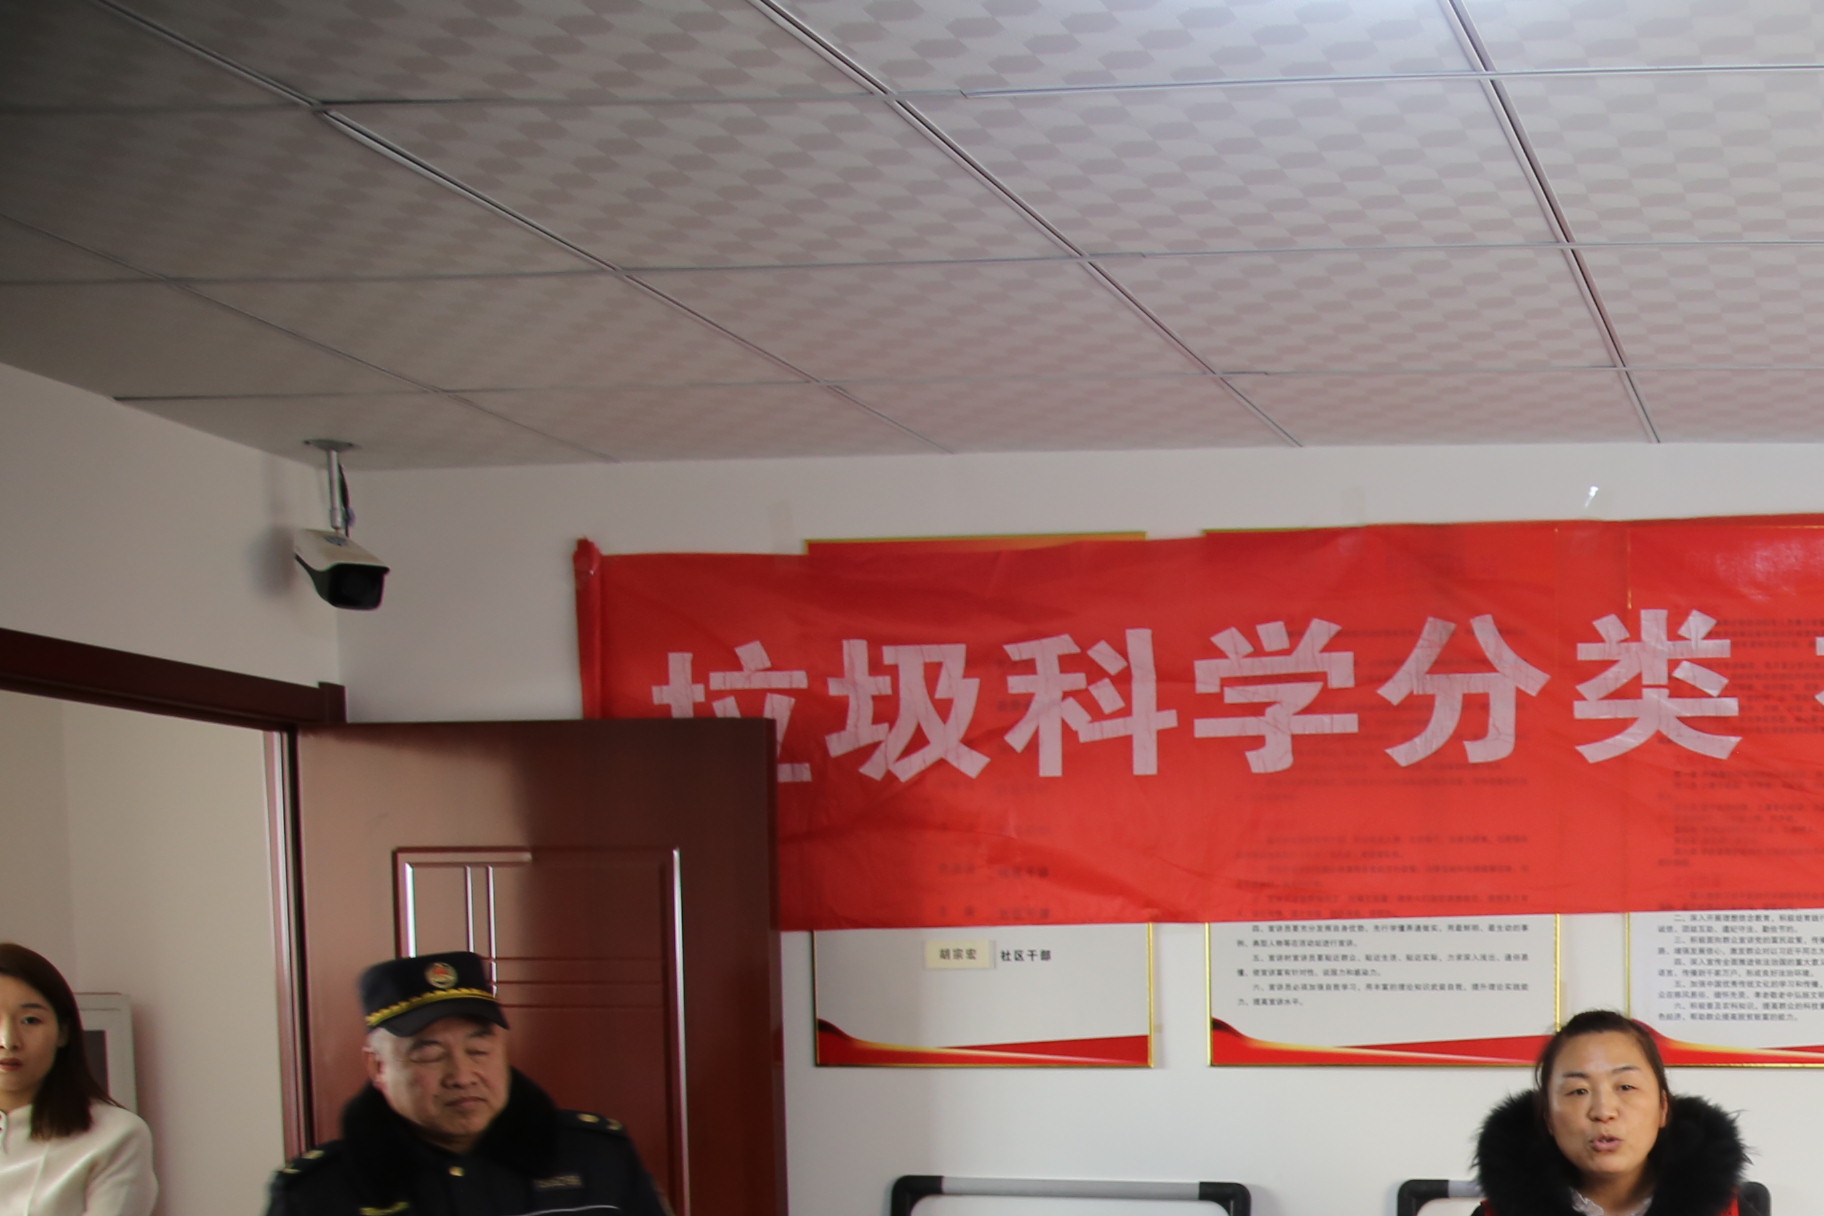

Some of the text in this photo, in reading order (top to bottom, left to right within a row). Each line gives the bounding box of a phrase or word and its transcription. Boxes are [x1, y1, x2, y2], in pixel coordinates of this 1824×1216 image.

[652, 607, 1740, 783] 垃圾科学分类
[1000, 949, 1052, 962] 社区干部
